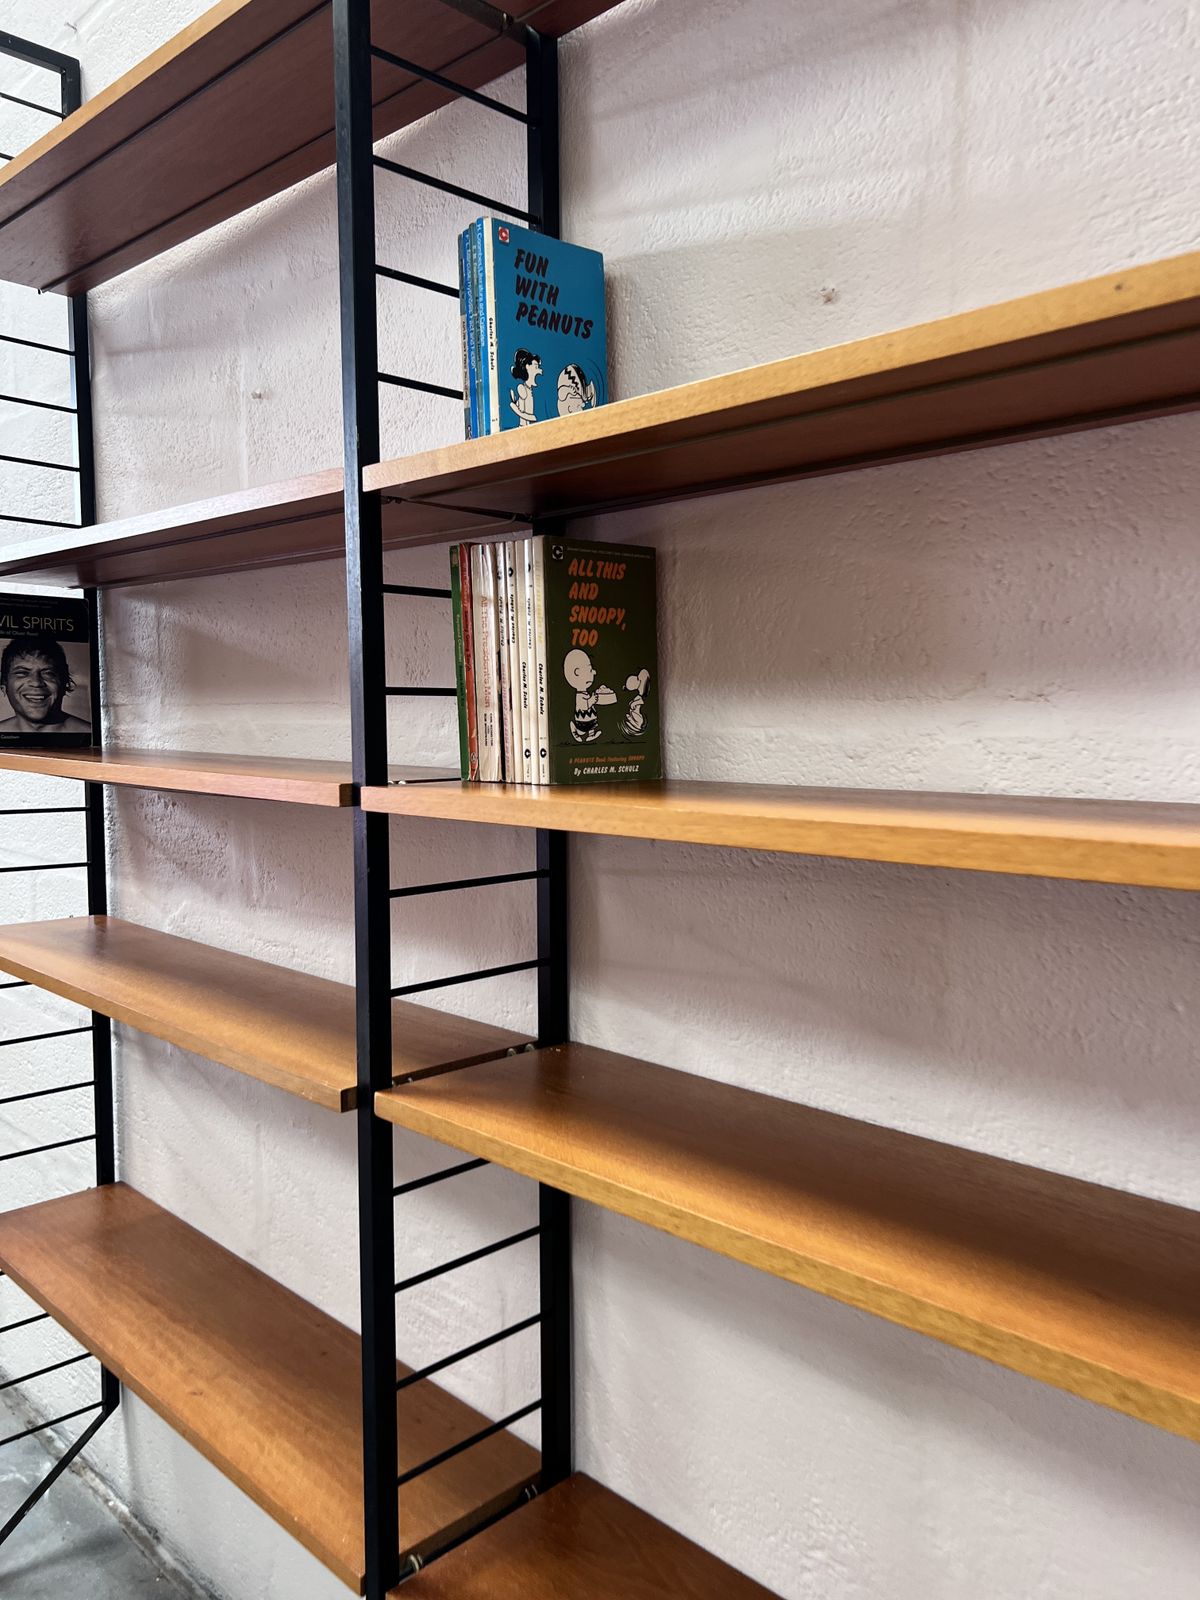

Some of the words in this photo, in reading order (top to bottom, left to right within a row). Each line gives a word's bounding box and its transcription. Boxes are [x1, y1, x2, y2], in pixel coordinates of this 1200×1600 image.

[514, 248, 549, 278] FUN
[515, 275, 560, 307] WITH
[515, 301, 594, 340] PEANUTS
[568, 558, 593, 577] ALL
[596, 559, 626, 580] THIS
[569, 582, 599, 600] AND
[22, 616, 74, 632] SPIRITS
[569, 604, 626, 631] SNOOPY,
[571, 628, 599, 647] TOO
[539, 686, 544, 694] M.
[573, 767, 582, 776] By
[582, 766, 608, 775] CHARLES
[618, 765, 640, 773] SCHULZ
